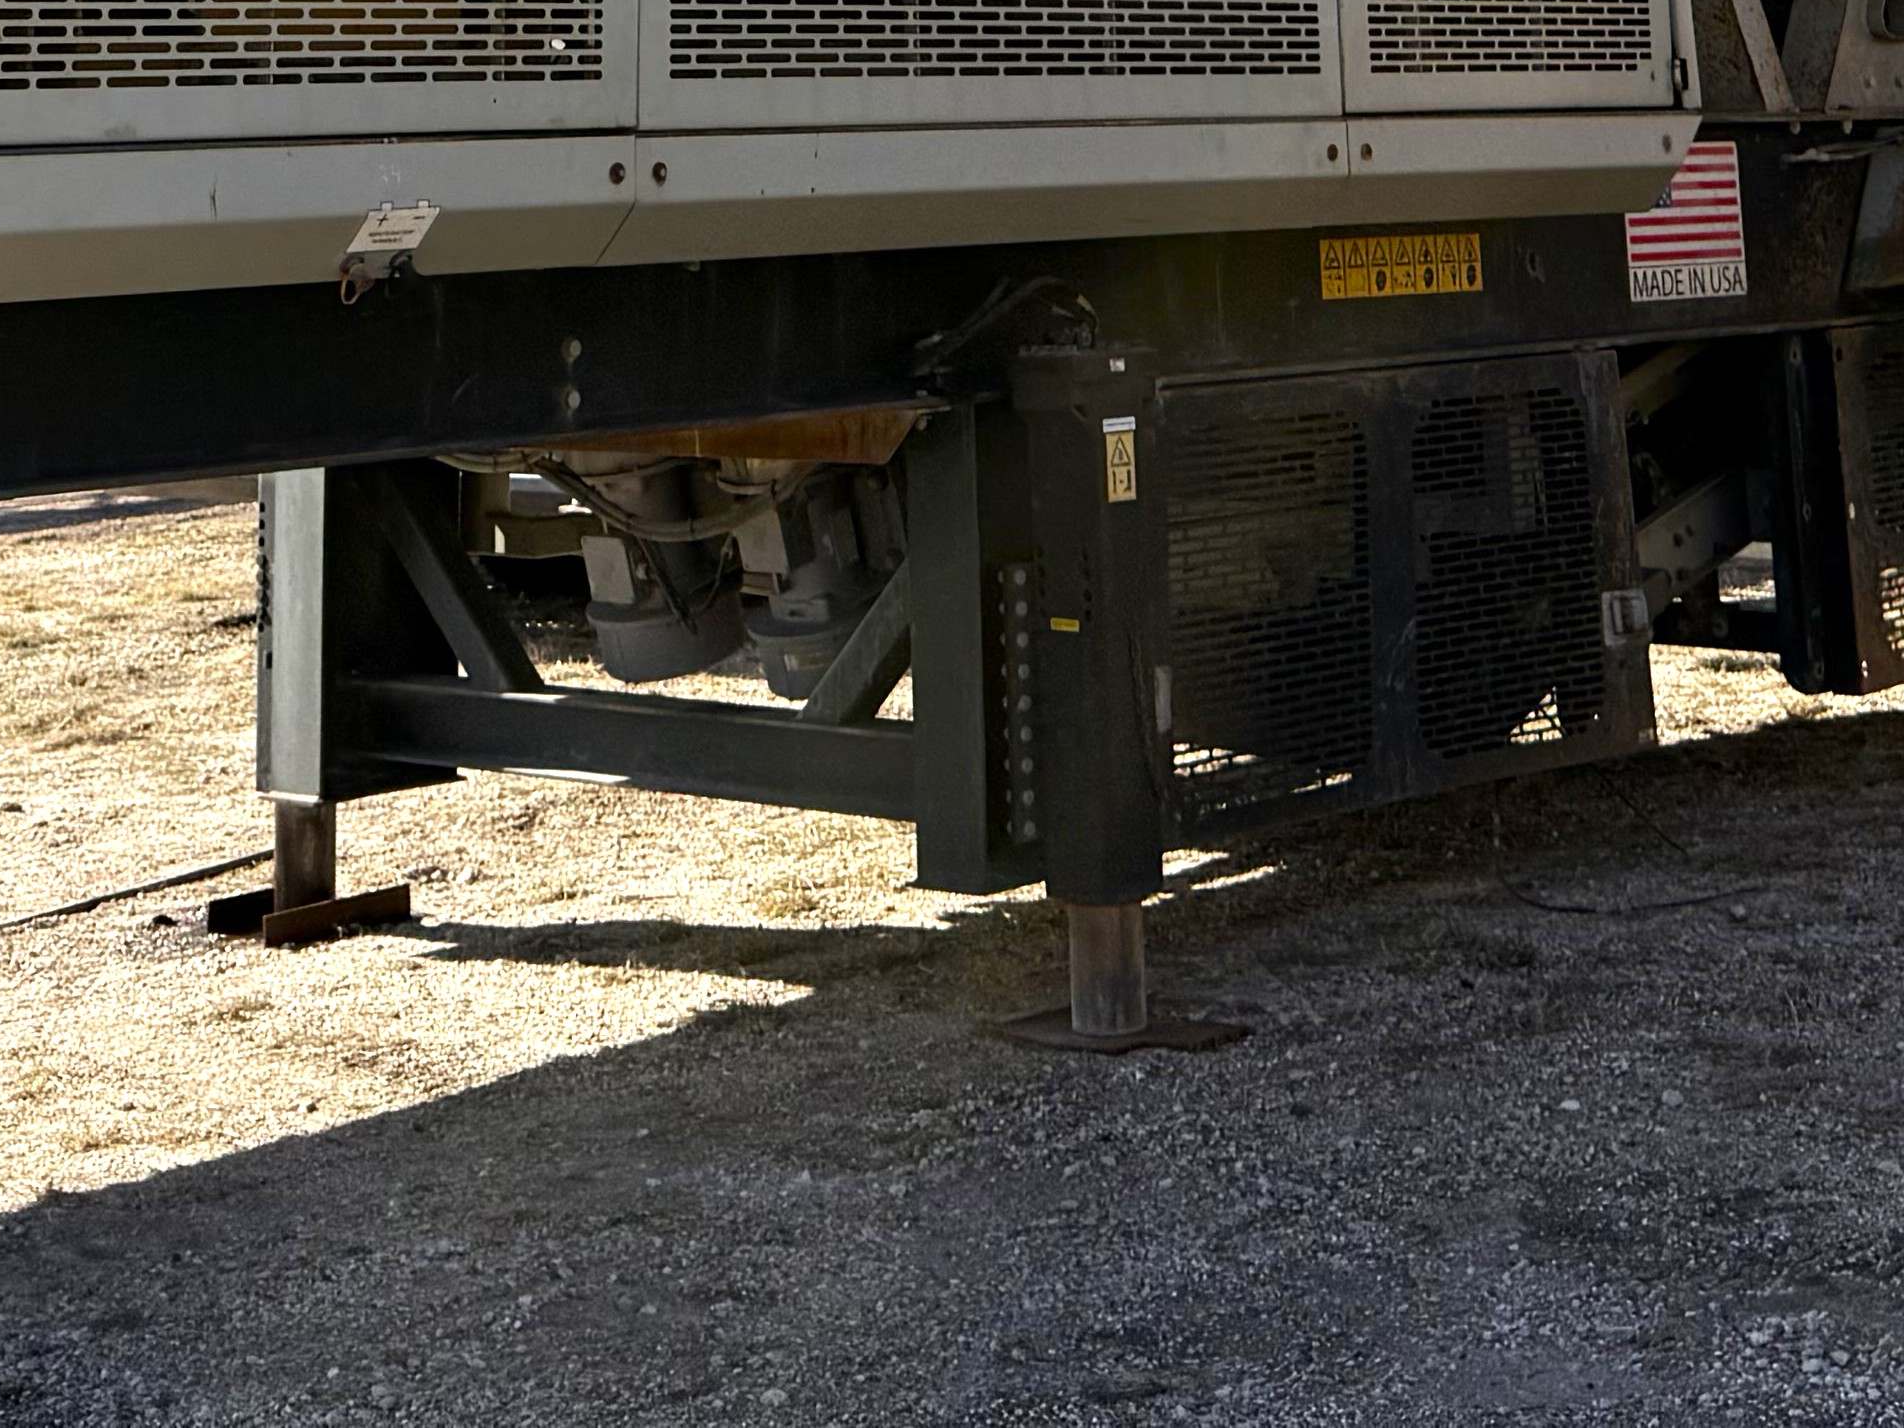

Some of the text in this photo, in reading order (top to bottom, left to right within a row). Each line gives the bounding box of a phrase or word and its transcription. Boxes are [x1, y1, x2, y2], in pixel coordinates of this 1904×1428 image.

[1633, 264, 1745, 298] MADE IN USA
